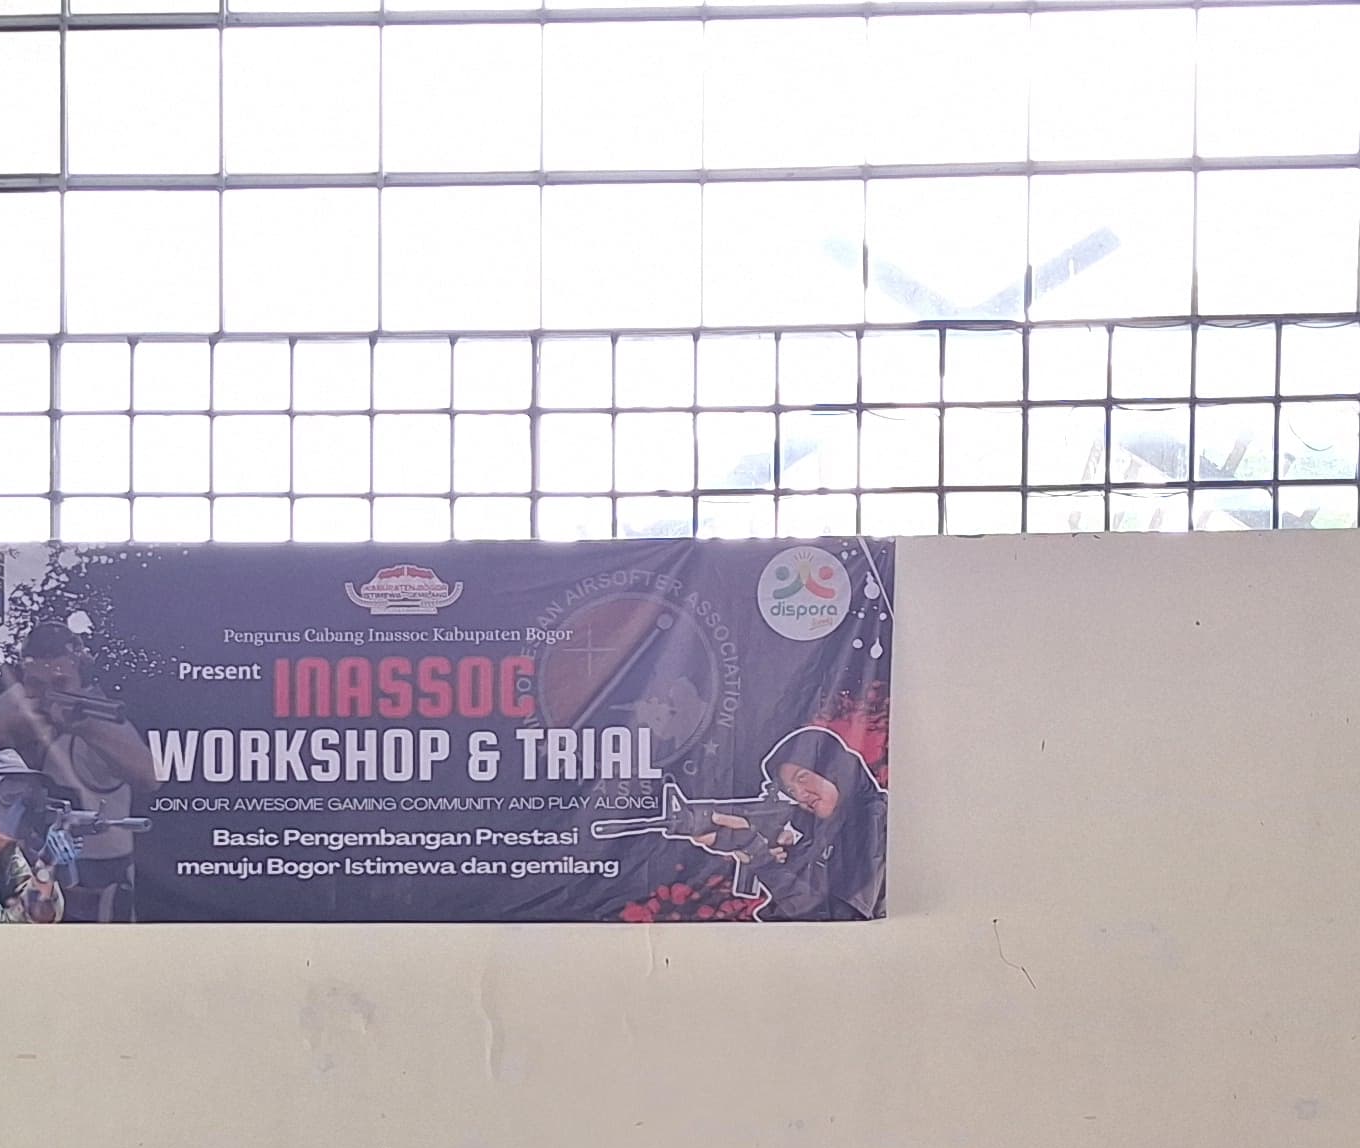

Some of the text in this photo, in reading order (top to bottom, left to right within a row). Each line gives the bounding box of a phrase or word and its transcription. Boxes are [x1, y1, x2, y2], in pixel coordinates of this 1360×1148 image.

[770, 601, 838, 620] dispora
[223, 627, 573, 646] Pengurus Cabang Inassoc Kabupaten Bogor
[178, 662, 262, 681] Present
[272, 656, 536, 719] INASSOC
[148, 726, 663, 782] WORKSHOP & TRIAL
[150, 796, 659, 812] JOIN OUR AWESOME GAMING COMMUNITY AND PLAY ALONG!
[212, 827, 579, 850] Basic Pengembangan Prestasi
[177, 857, 620, 879] menuju Bogor Istimewa dan gemilang
